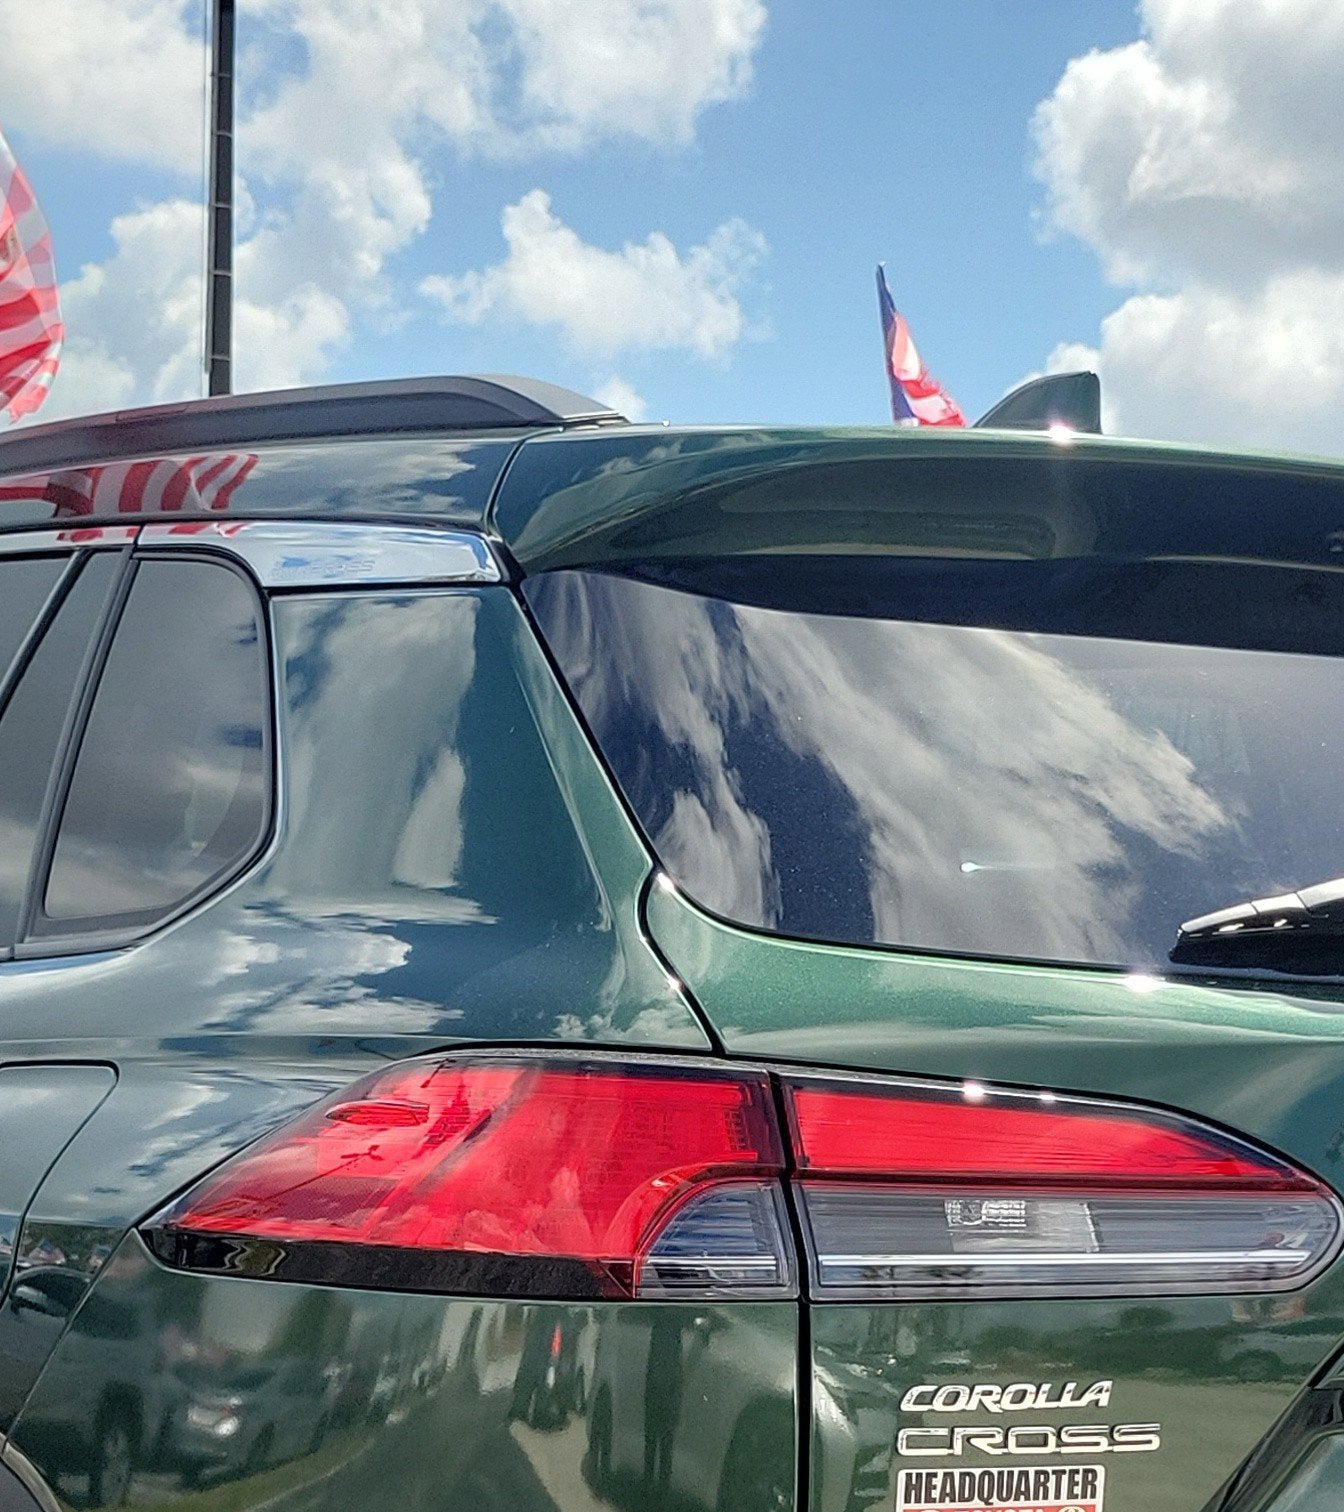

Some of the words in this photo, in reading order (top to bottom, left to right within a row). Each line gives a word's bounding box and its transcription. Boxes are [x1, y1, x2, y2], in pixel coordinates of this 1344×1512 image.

[899, 1380, 1113, 1413] COROLLA
[897, 1423, 1161, 1456] CROSS
[904, 1467, 1098, 1506] HEADQUARTER
